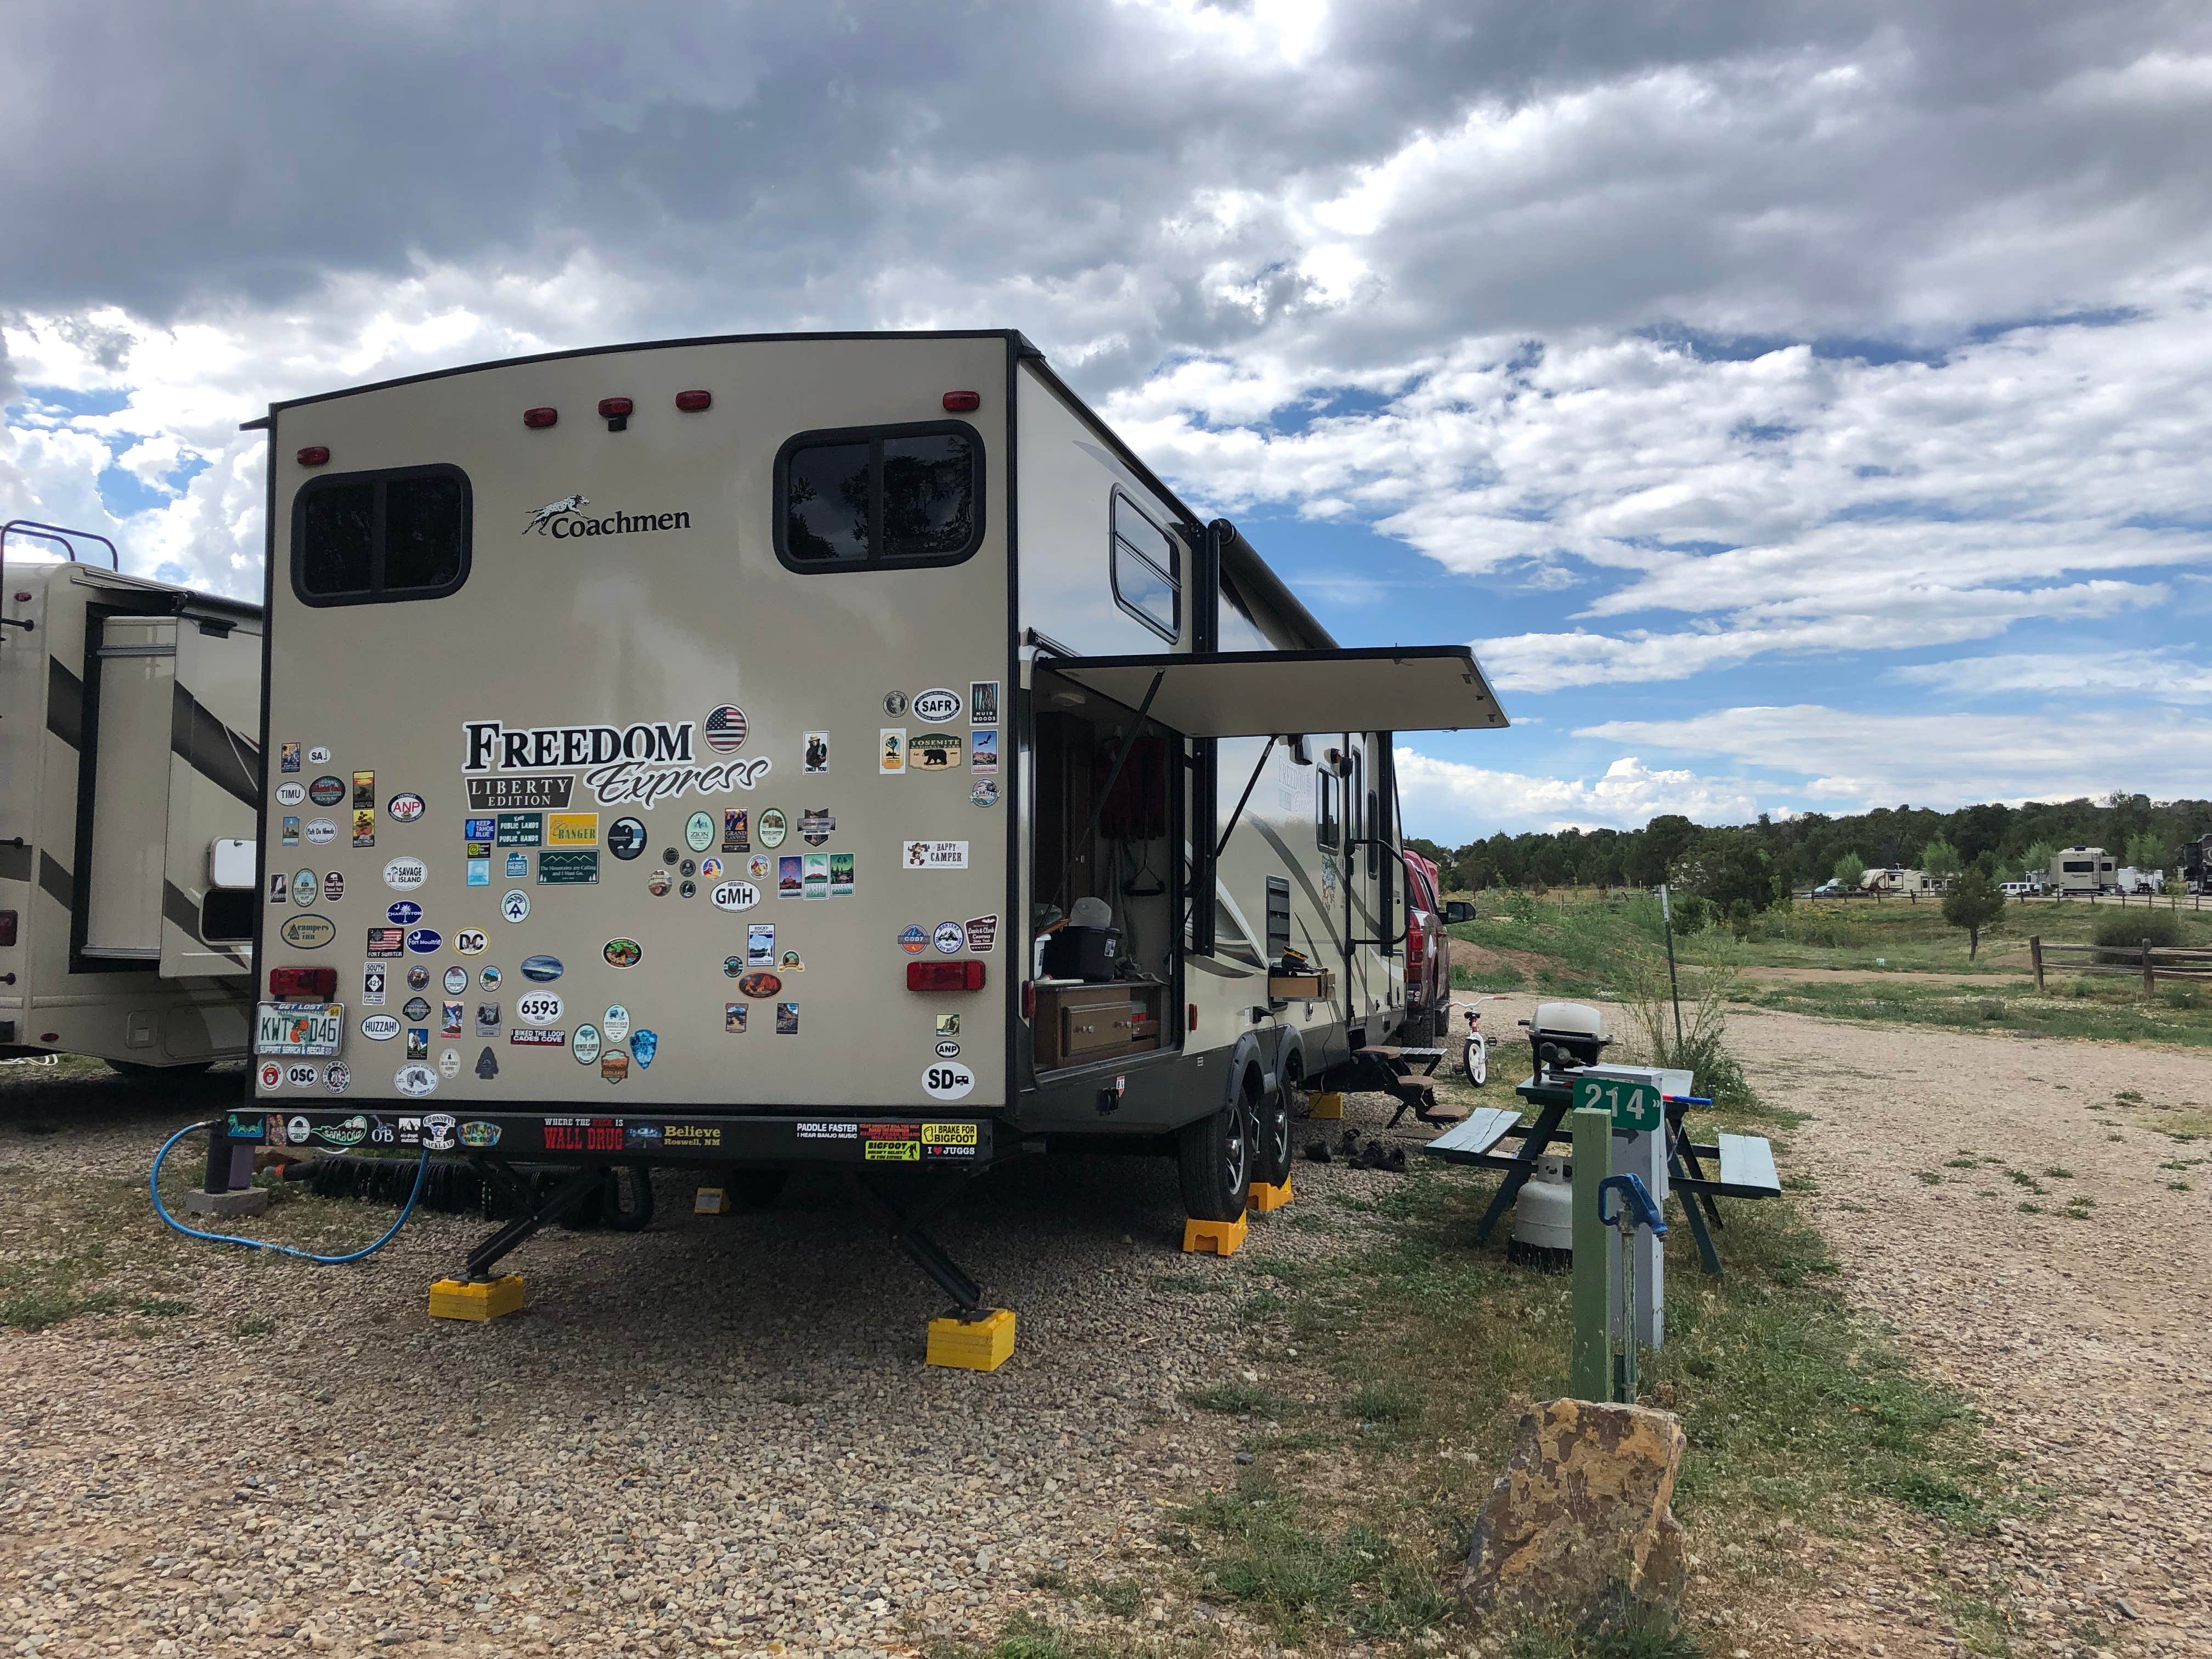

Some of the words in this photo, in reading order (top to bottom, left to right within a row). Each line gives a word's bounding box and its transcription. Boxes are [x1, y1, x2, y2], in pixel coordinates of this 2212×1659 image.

[551, 510, 691, 539] Coachmen
[922, 700, 952, 712] SAFR
[465, 723, 693, 770] FREEDOM
[471, 778, 569, 795] LIBERTY
[587, 760, 769, 808] Express
[280, 789, 301, 799] TIMU
[487, 794, 551, 806] EDITION
[392, 802, 420, 812] ANP
[558, 828, 596, 839] RANGER
[936, 843, 956, 851] HAPPY
[930, 852, 962, 862] CAMPER
[398, 867, 422, 876] SAVAGE
[715, 888, 753, 904] GMH
[459, 934, 484, 950] DC
[521, 1000, 558, 1015] 6593
[261, 1017, 291, 1041] KWT
[365, 1021, 397, 1032] HUZZAH!
[290, 1068, 314, 1082] OSC
[340, 1062, 349, 1076] PARK
[928, 1069, 954, 1089] SD
[324, 1081, 341, 1093] GALLUP
[1585, 1084, 1645, 1120] 214
[424, 1115, 455, 1125] CROSSFIT
[664, 1125, 721, 1138] Believe
[797, 1123, 827, 1131] PADDLE
[828, 1124, 857, 1132] FASTER
[934, 1125, 936, 1133] I
[938, 1125, 960, 1134] BRAKE
[962, 1126, 975, 1134] FOR
[371, 1128, 394, 1142] OB
[544, 1127, 583, 1149] WALL
[587, 1127, 623, 1150] DRUG
[934, 1134, 975, 1143] BIGFOOT
[424, 1138, 454, 1149] LACKLAND
[664, 1138, 702, 1147] Roswell,
[943, 1147, 975, 1155] JUGGS
